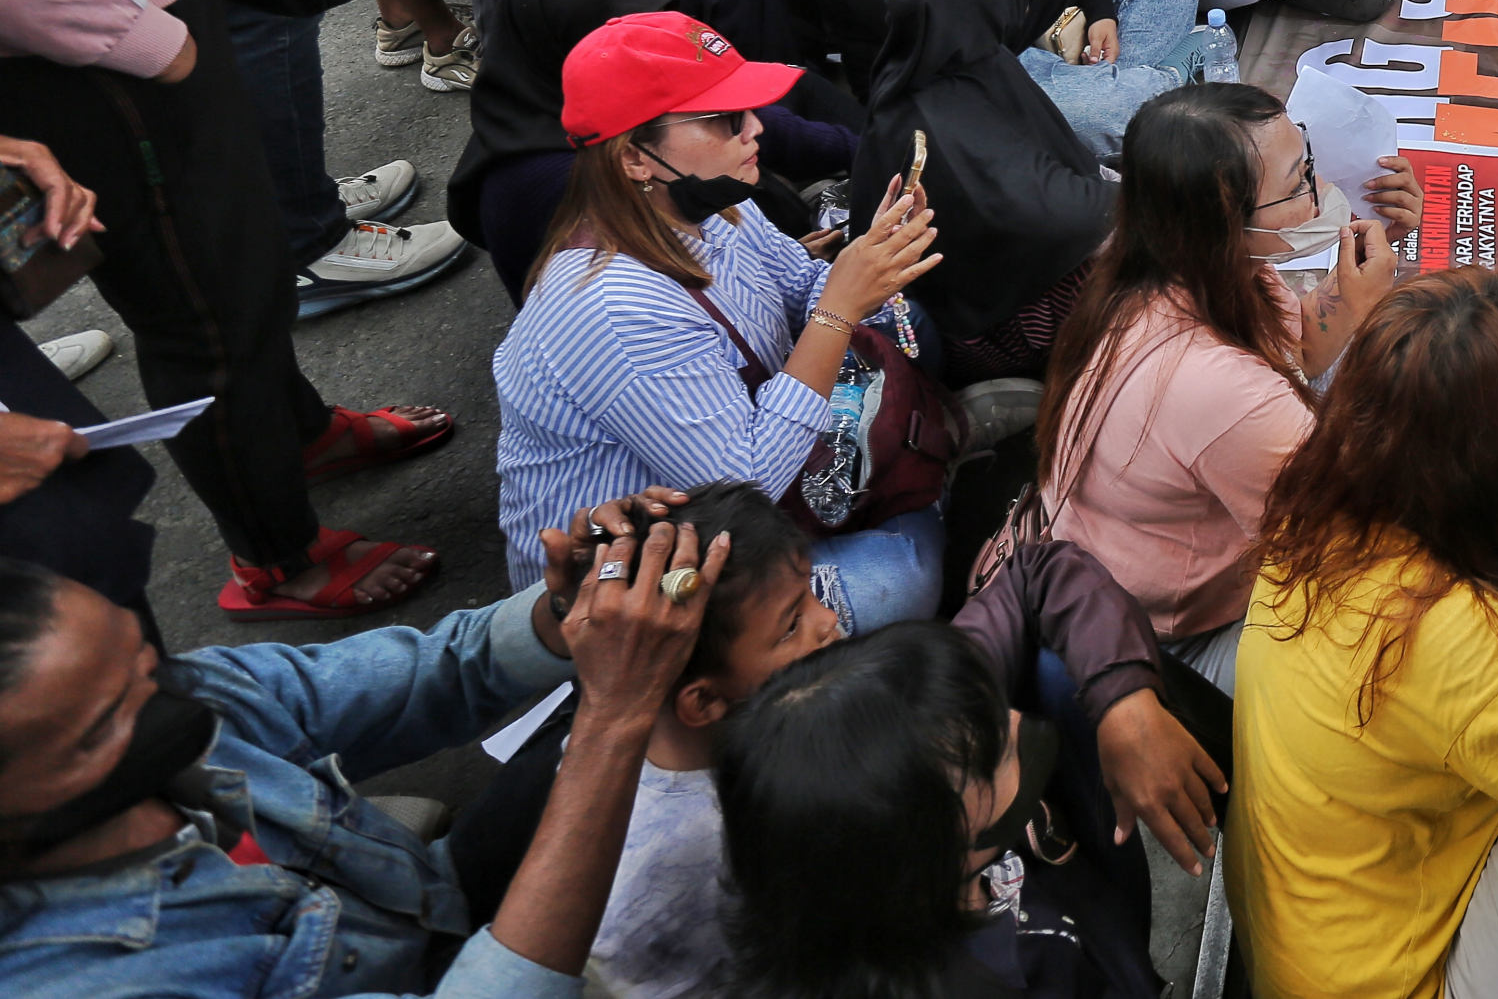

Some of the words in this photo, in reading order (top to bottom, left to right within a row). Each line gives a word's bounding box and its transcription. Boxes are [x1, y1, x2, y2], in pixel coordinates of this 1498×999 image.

[1456, 163, 1475, 234] TERHADAP
[1403, 226, 1419, 262] adala
[1456, 237, 1473, 268] ARA
